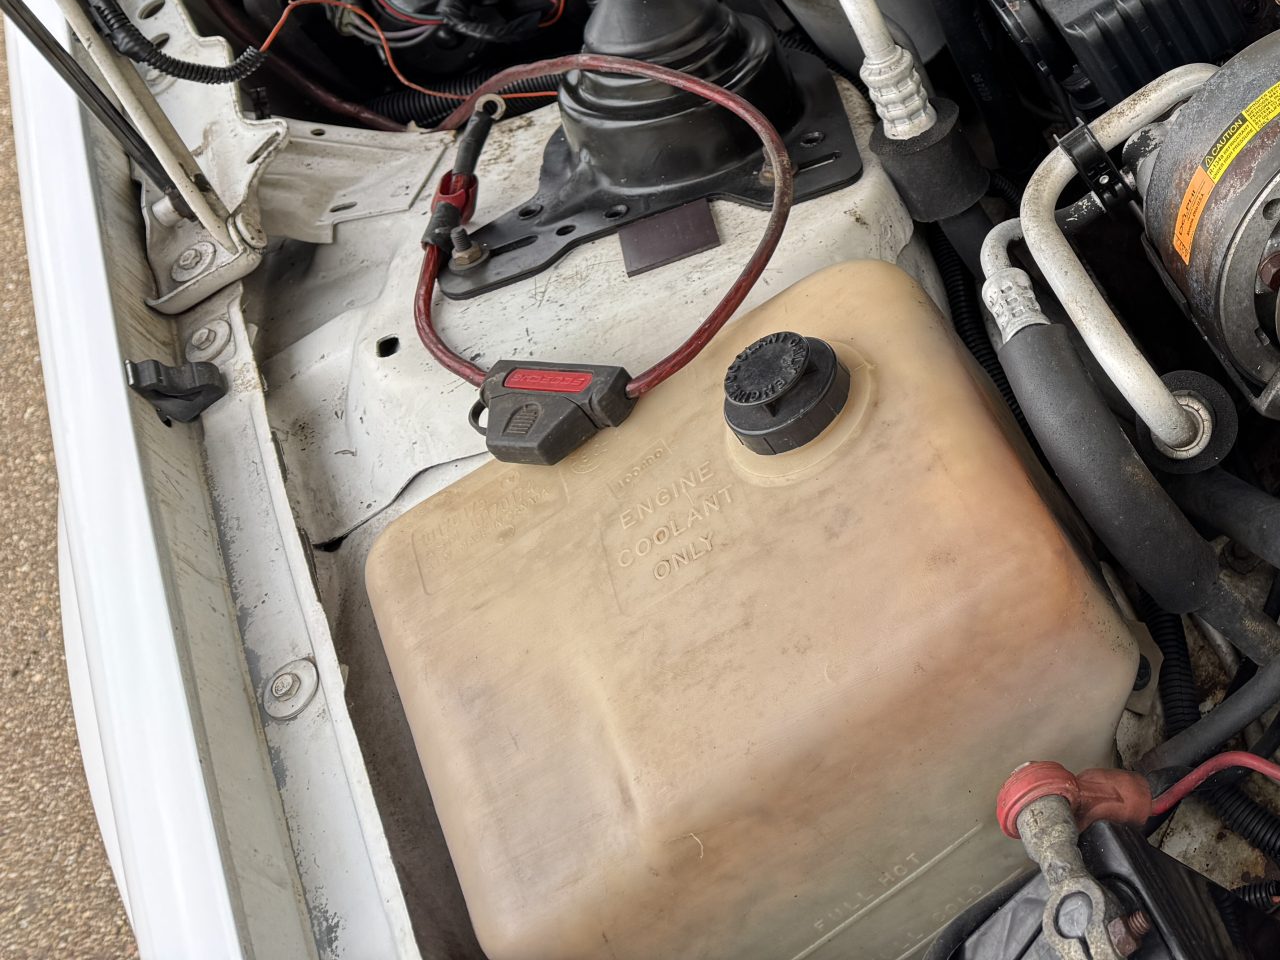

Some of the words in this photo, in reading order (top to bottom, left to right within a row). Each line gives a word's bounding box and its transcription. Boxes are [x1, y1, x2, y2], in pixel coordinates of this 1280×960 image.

[1245, 93, 1268, 114] IMPROPER
[1247, 98, 1269, 117] METHODS
[1250, 99, 1273, 119] PERSONAL
[1252, 107, 1271, 122] SYSTEM
[1208, 154, 1223, 176] R-134a
[1222, 124, 1250, 155] REFRIGERANT
[1211, 119, 1243, 156] CAUTION
[1212, 163, 1225, 180] UNDER
[1232, 128, 1254, 153] PRESSURE
[619, 460, 717, 530] ENGINE
[616, 485, 736, 569] COOLANT
[652, 533, 717, 582] ONLY
[814, 891, 874, 933] FULL
[878, 852, 920, 887] HOT
[932, 884, 984, 923] COLD
